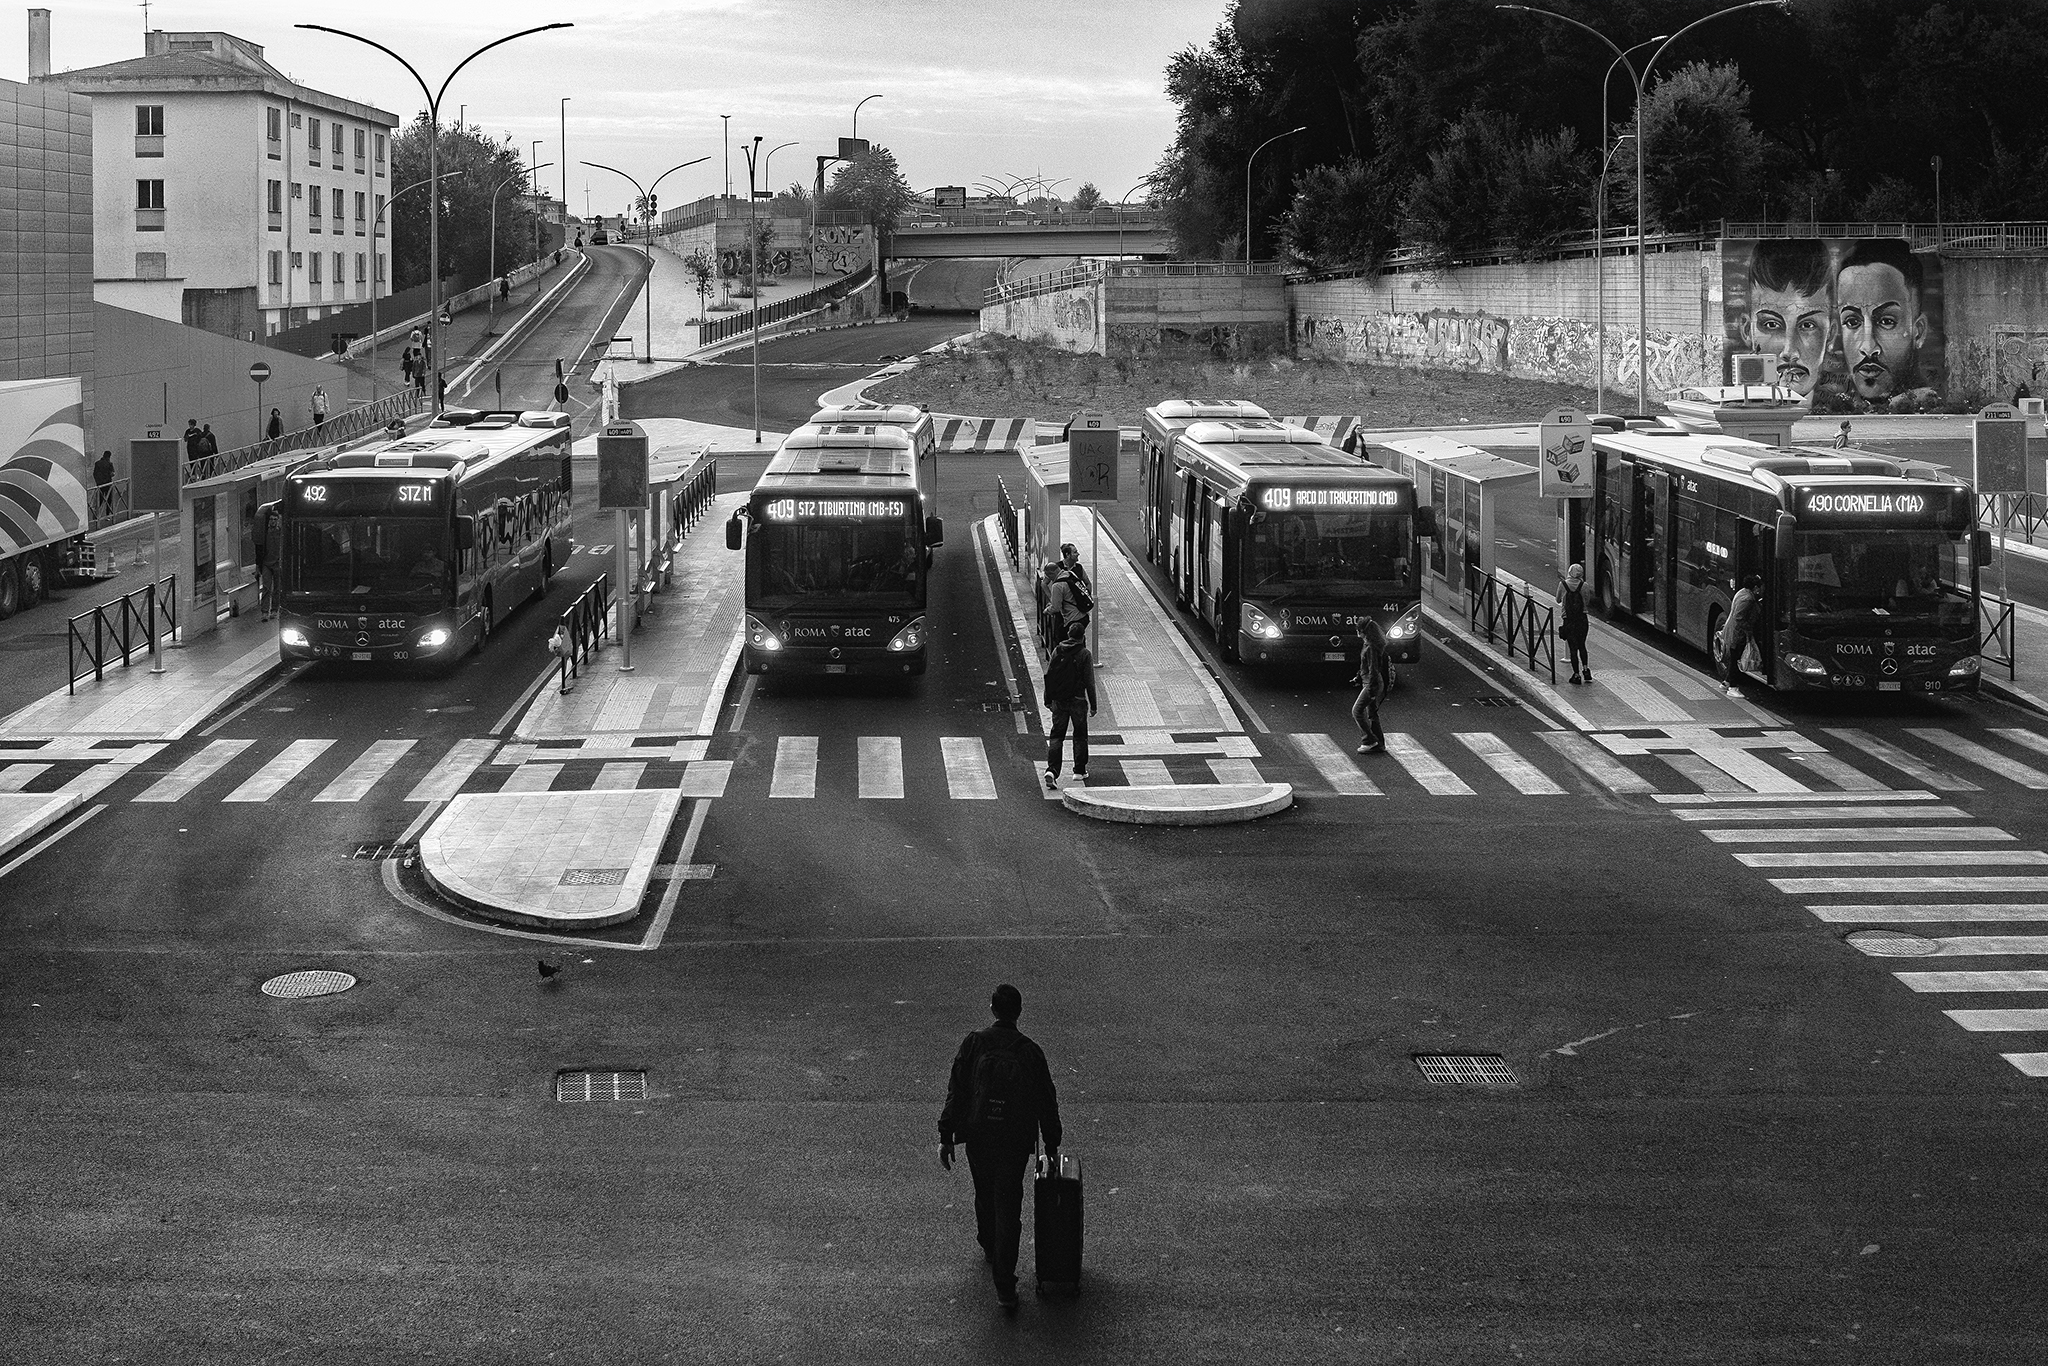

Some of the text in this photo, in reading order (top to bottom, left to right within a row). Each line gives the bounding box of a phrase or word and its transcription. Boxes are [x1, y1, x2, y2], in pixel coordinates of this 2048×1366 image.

[303, 485, 432, 501] 492 STZ M
[1264, 488, 1398, 508] 409 ARCO DI TRAVERTINO (MA)
[1807, 495, 1924, 512] 490 CORNELIA (MA)
[767, 499, 795, 519] 409
[818, 501, 866, 516] TIBURTINA
[868, 501, 904, 516] (MB-FS)
[1383, 603, 1399, 612] 441
[317, 620, 348, 629] ROMA
[378, 619, 406, 629] atac
[1295, 616, 1328, 625] ROMA
[794, 628, 826, 637] ROMA
[844, 626, 871, 637] atac
[1836, 644, 1873, 655] ROMA
[1907, 644, 1937, 656] atac
[393, 651, 409, 660] 900
[1924, 681, 1941, 690] 910
